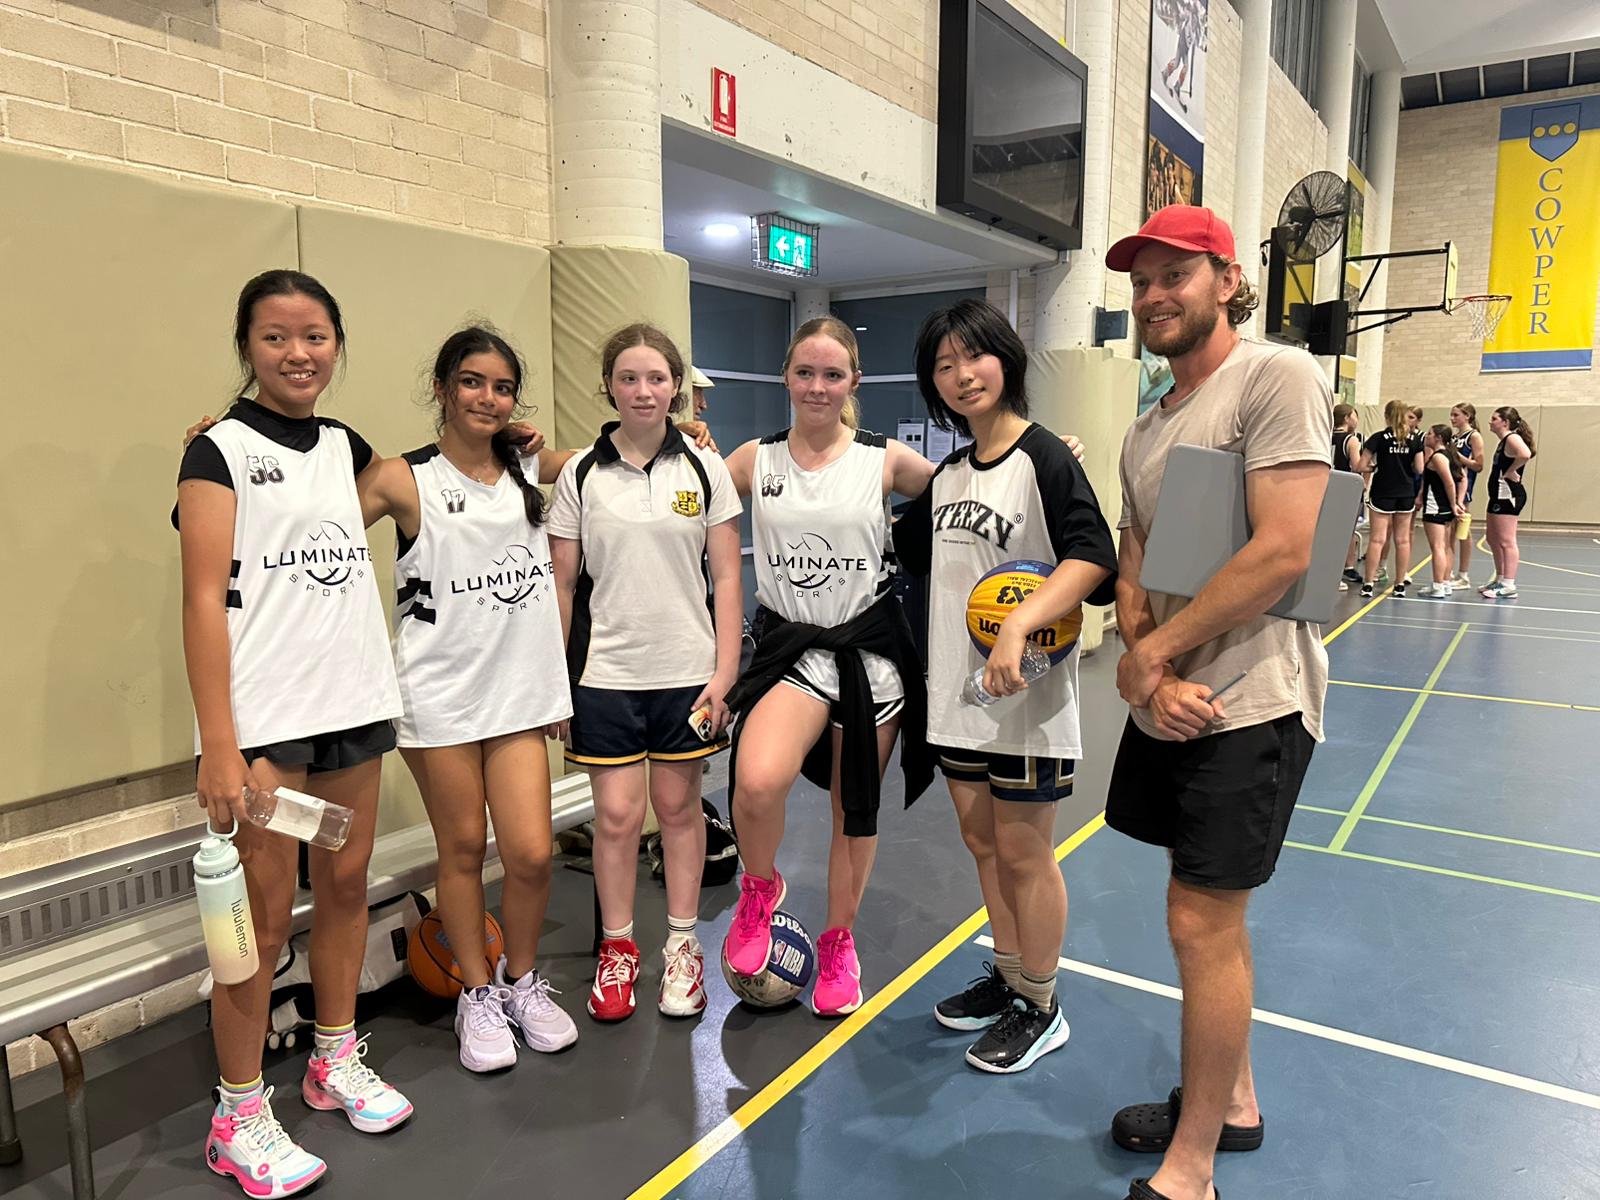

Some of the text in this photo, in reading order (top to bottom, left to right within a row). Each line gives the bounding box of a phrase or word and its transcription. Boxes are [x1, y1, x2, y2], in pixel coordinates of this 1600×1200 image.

[1528, 167, 1565, 335] COWPER
[246, 455, 285, 486] 56
[440, 488, 466, 514] 17
[766, 552, 867, 571] UMINATE
[289, 569, 365, 597] SPORTS
[775, 573, 846, 598] SORTS
[477, 583, 550, 615] SPORTS
[230, 898, 249, 959] lululemon
[779, 944, 806, 978] NBA
